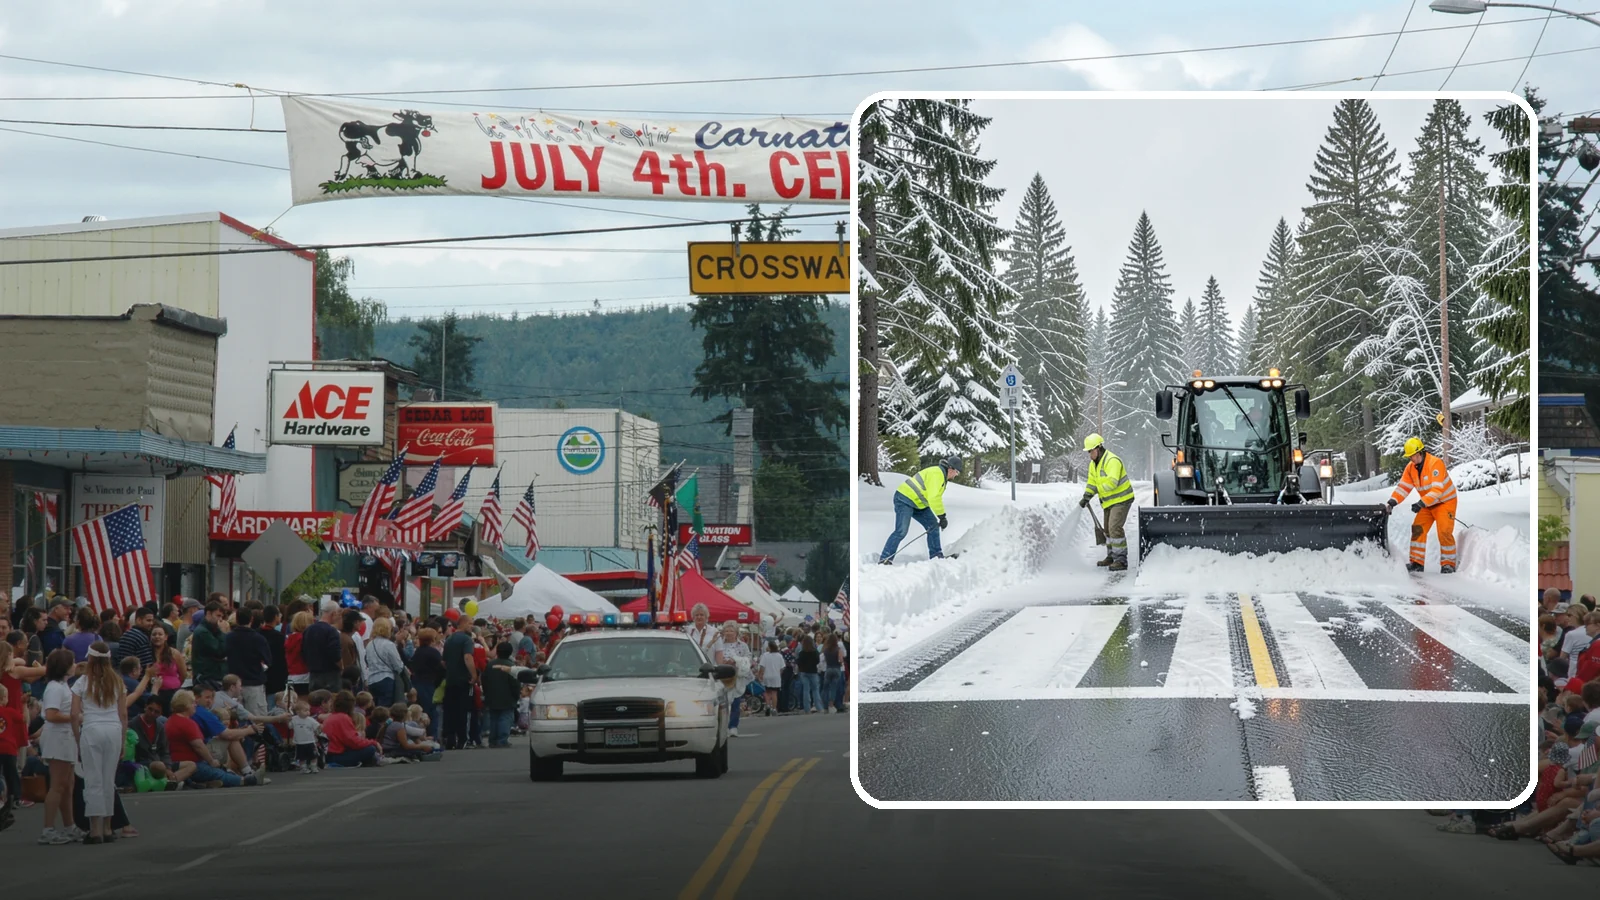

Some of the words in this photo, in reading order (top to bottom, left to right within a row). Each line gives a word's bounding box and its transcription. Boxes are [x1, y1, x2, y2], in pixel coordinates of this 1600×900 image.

[481, 141, 604, 192] JULY
[632, 150, 746, 197] 4th.
[697, 254, 850, 280] CROSSWA
[283, 380, 373, 420] ACE
[405, 409, 452, 422] CEDAR
[283, 421, 370, 436] Hardware
[416, 428, 477, 447] Coca-Cola
[353, 467, 385, 480] Simpl
[95, 485, 124, 494] Vincent
[126, 486, 136, 494] de
[137, 486, 155, 495] Paul
[213, 516, 331, 535] HARDARE
[688, 526, 741, 535] CRNATION
[699, 535, 730, 543] GLASS
